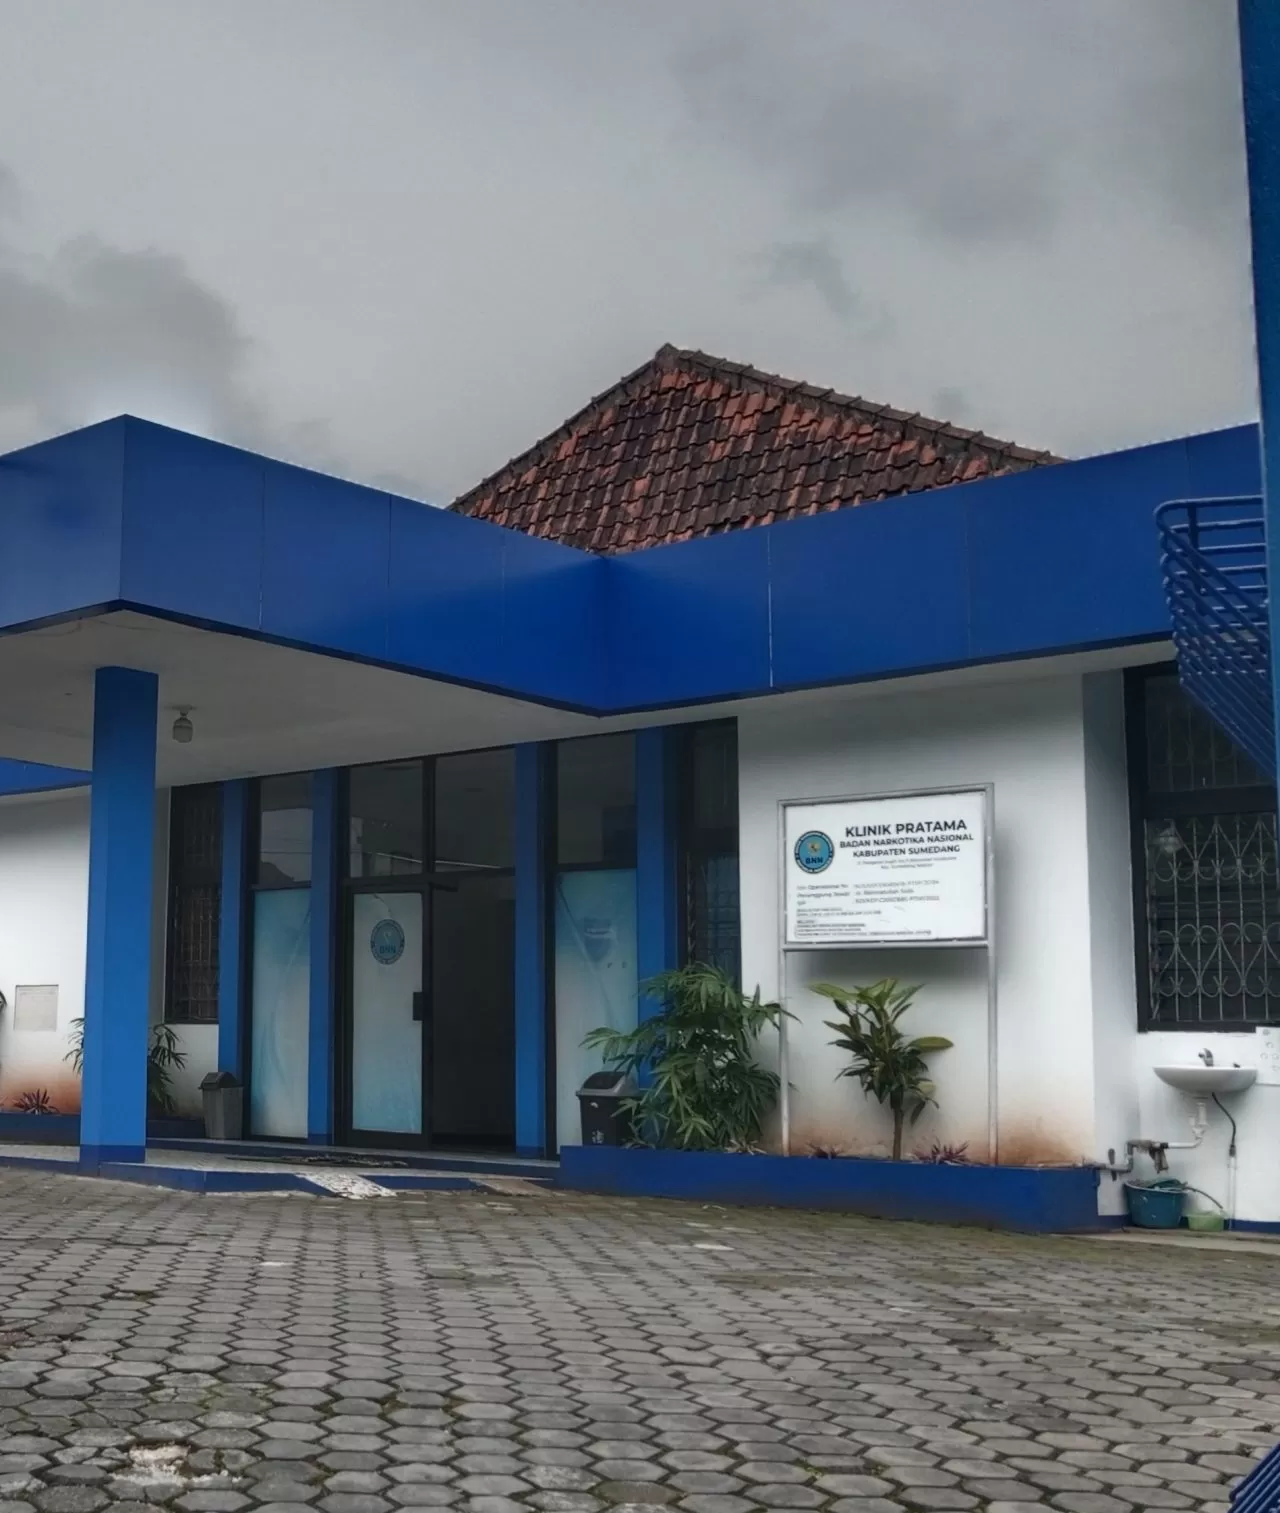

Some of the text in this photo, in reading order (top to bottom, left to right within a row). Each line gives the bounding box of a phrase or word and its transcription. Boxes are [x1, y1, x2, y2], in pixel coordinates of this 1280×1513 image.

[845, 819, 968, 838] KLINIK PRATAMA
[839, 833, 974, 849] BADAN NARKOTIKA NASIONAL
[852, 844, 961, 858] KABUPATEN SUMEDANG
[805, 856, 824, 864] BNN
